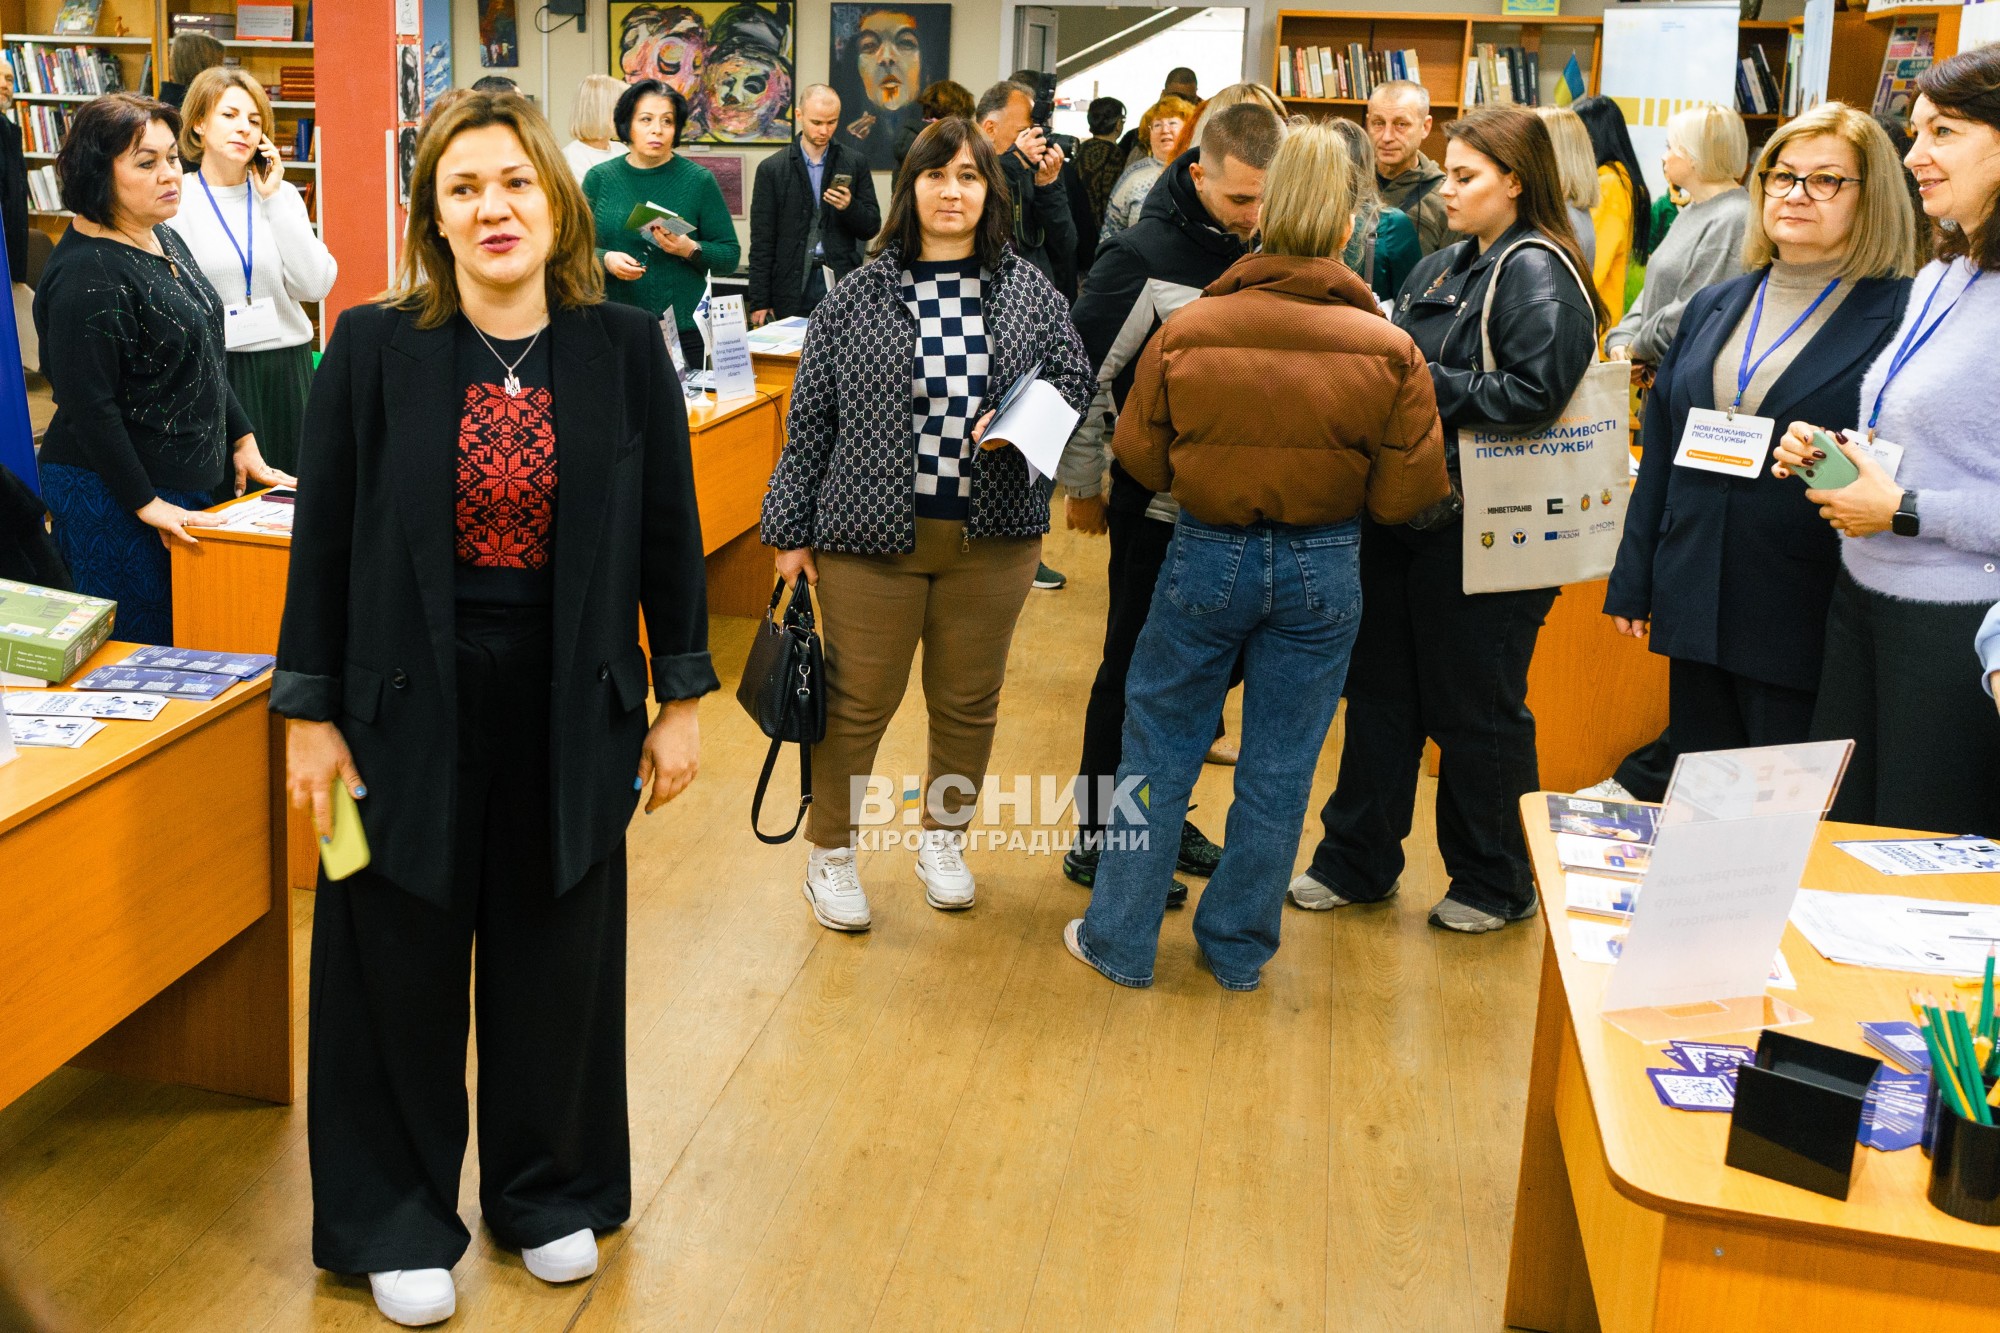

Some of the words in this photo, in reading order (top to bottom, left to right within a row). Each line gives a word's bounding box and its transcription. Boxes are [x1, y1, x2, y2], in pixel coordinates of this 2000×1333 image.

[1692, 431, 1713, 439] ПІСЛЯ
[1714, 434, 1747, 444] СЛУЖБИ
[1712, 426, 1763, 440] МОЖЛИВОСТІ
[1476, 445, 1525, 459] ПІСЛЯ
[1529, 439, 1594, 456] СЛУЖБИ
[1487, 505, 1532, 514] МІНВЕТЕРАНІВ
[1558, 532, 1580, 540] РАЗОМ
